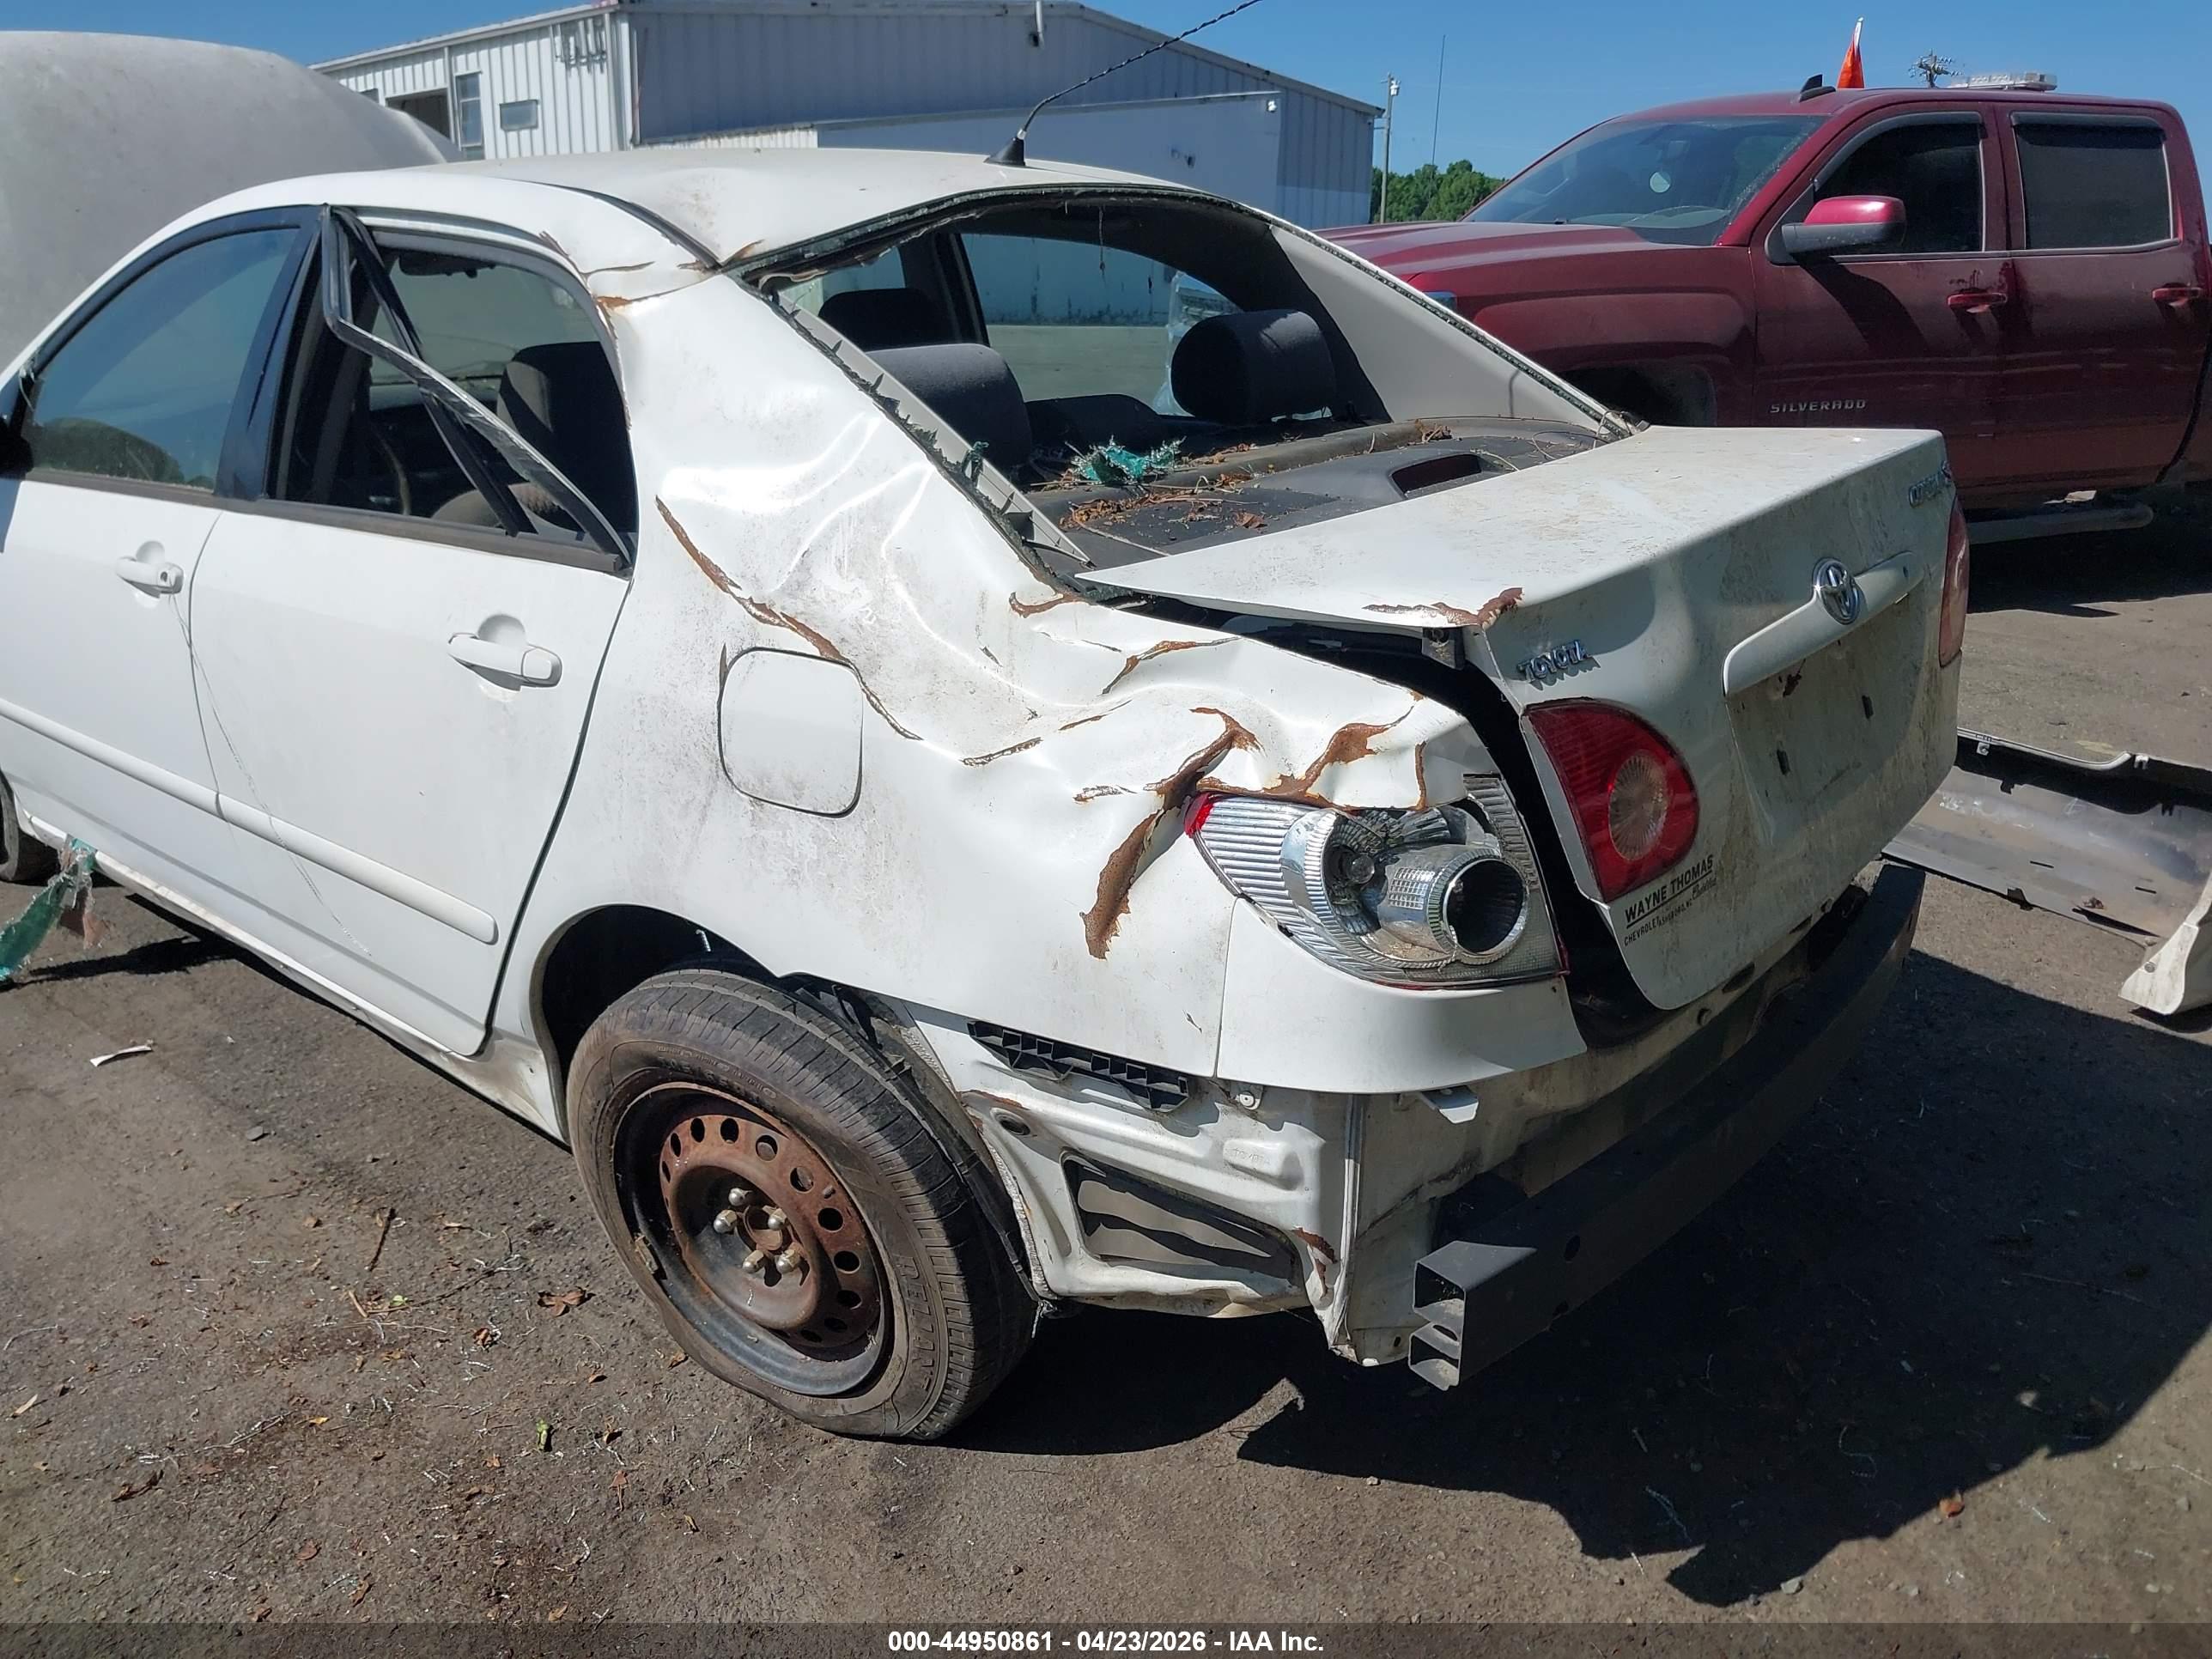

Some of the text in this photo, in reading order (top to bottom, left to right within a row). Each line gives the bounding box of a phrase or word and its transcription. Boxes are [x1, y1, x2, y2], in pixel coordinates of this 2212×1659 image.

[1770, 398, 1867, 413] SILVERADO
[1516, 641, 1587, 682] TOYOTA
[1625, 854, 1713, 923] WAYNE THOMAS
[1624, 916, 1658, 946] CHEVROLET
